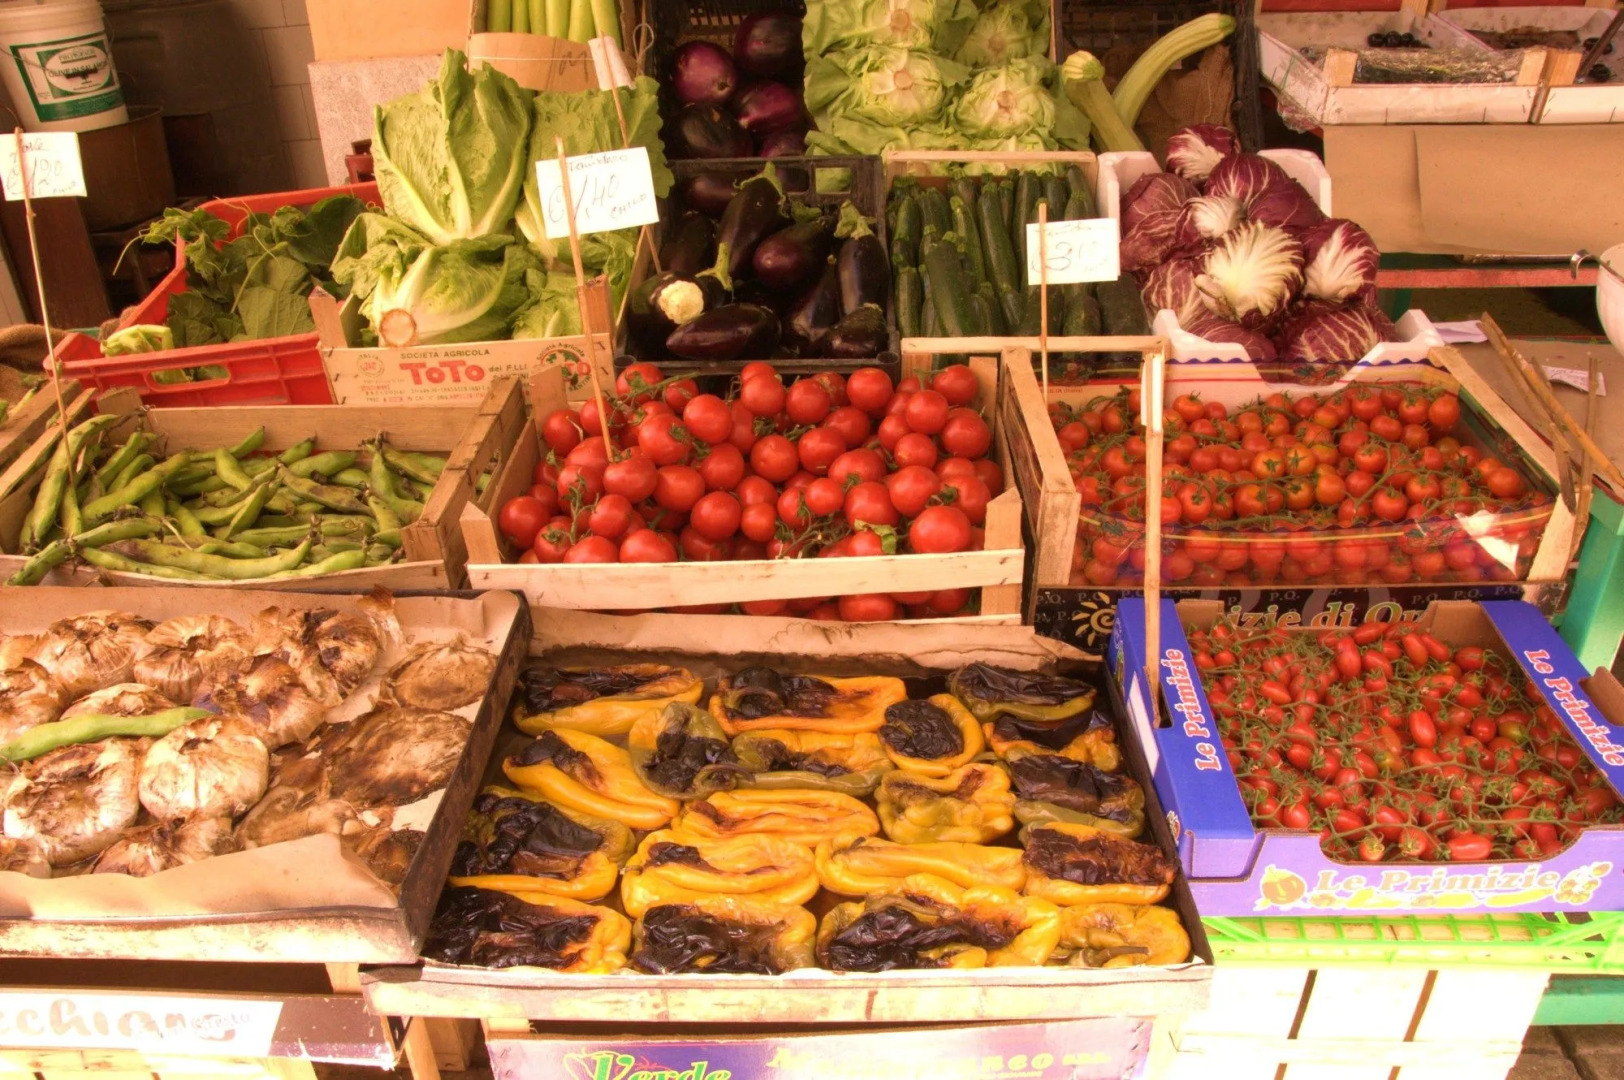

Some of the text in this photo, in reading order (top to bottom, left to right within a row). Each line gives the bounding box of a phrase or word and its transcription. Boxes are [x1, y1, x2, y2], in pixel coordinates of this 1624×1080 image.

[49, 66, 71, 77] OLIVE
[443, 349, 490, 358] AGRICOLA
[1269, 590, 1300, 602] P.Q.
[1453, 587, 1483, 600] P.Q.
[1311, 602, 1356, 628] di
[1161, 648, 1222, 771] Le Primizie
[1524, 649, 1624, 766] Le Primizie
[1315, 865, 1560, 892] Le Primizie
